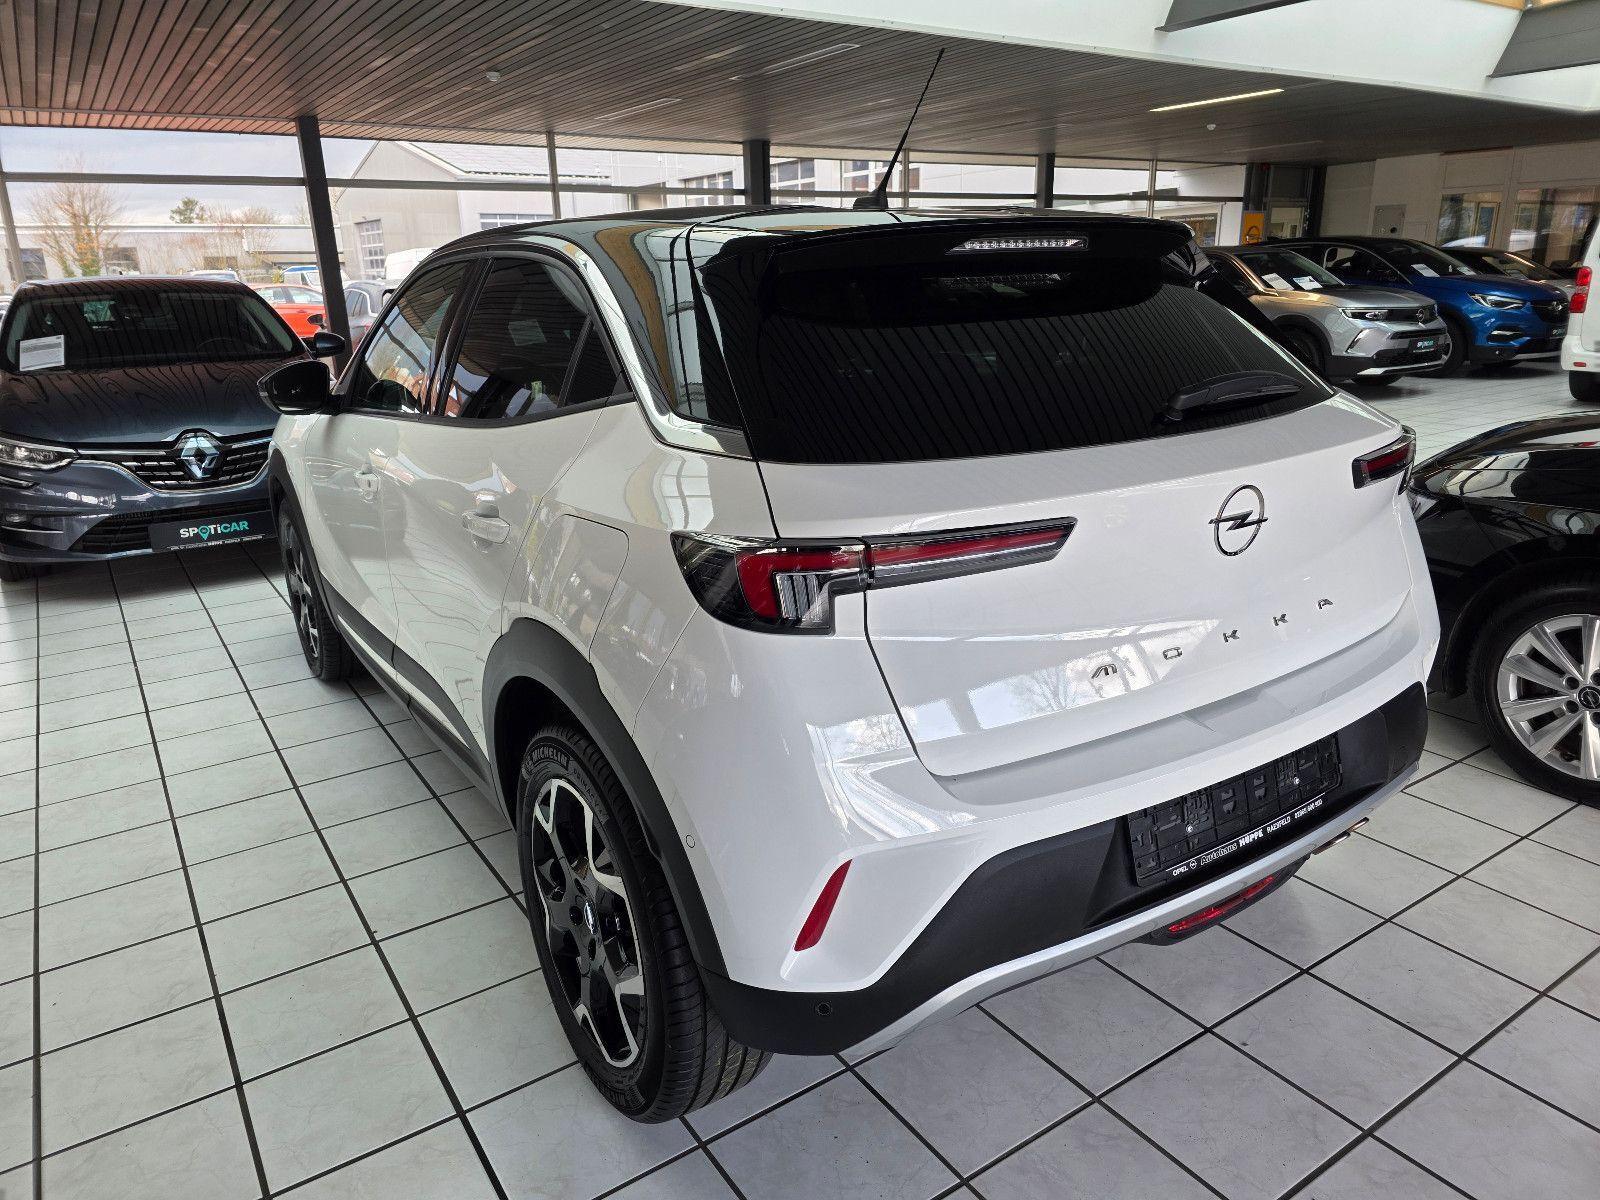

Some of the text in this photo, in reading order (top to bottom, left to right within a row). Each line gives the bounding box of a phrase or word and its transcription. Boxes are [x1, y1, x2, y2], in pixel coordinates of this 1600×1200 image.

[532, 746, 567, 769] MICHELIN
[1172, 865, 1189, 876] OPEL
[1200, 842, 1238, 866] Autohaus
